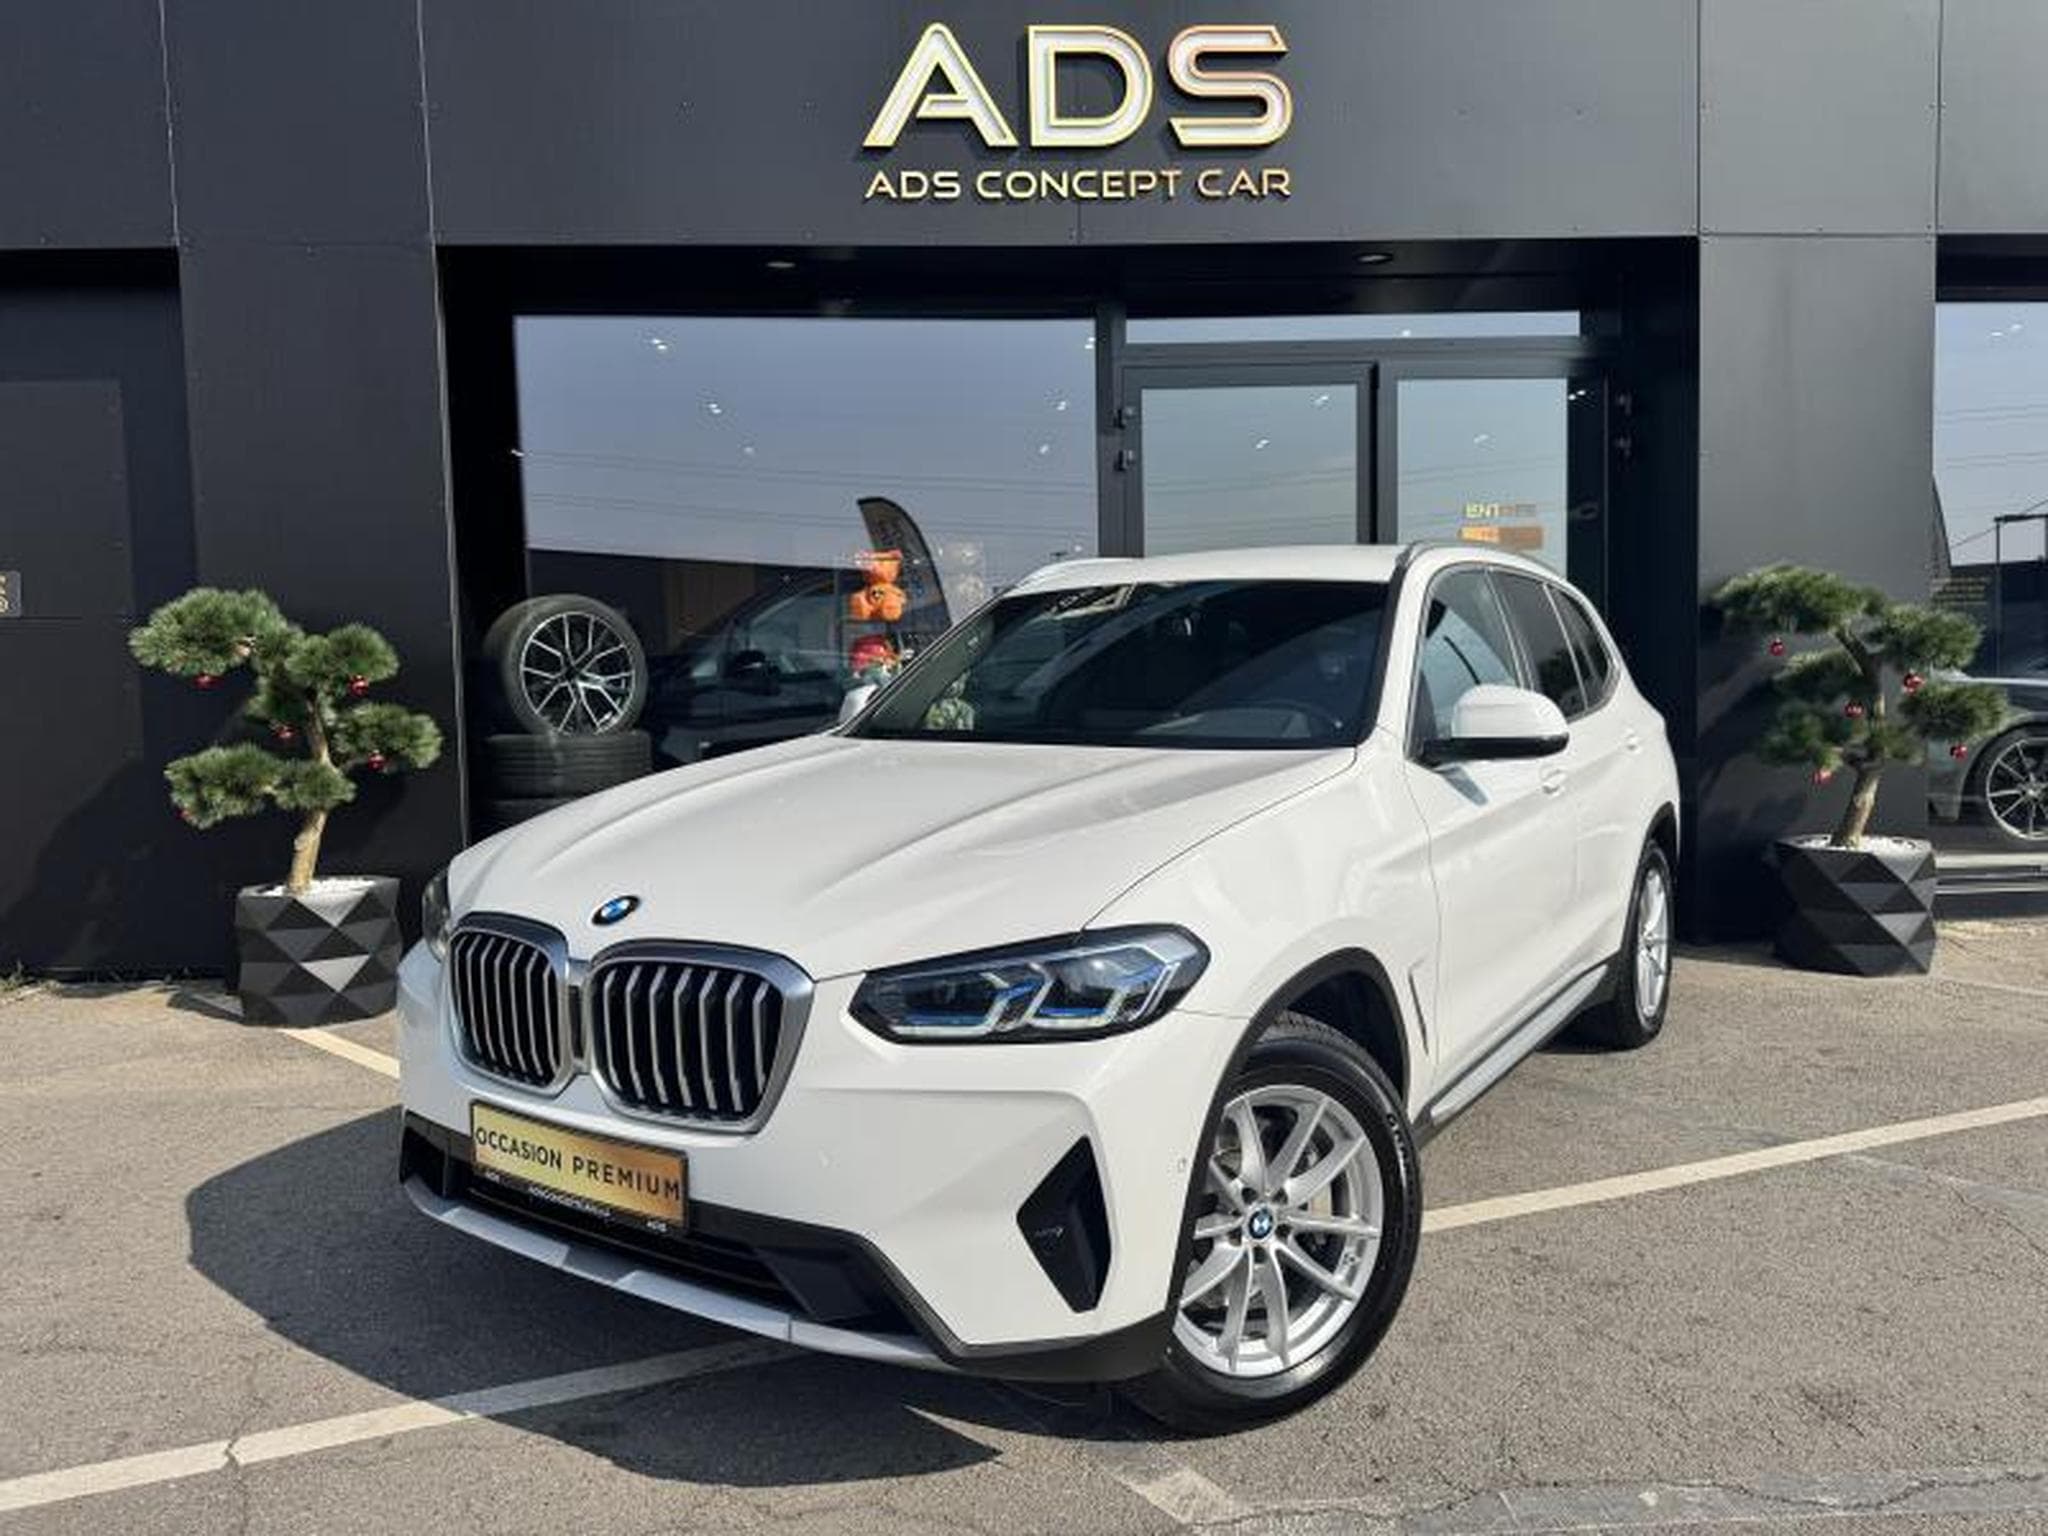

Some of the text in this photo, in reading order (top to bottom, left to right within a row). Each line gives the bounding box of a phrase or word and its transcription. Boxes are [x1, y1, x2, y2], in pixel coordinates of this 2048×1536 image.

[863, 23, 1293, 147] ADS
[864, 168, 1291, 199] ADS CONCEPT CAR
[475, 1127, 681, 1201] OCCASION PREMIUM
